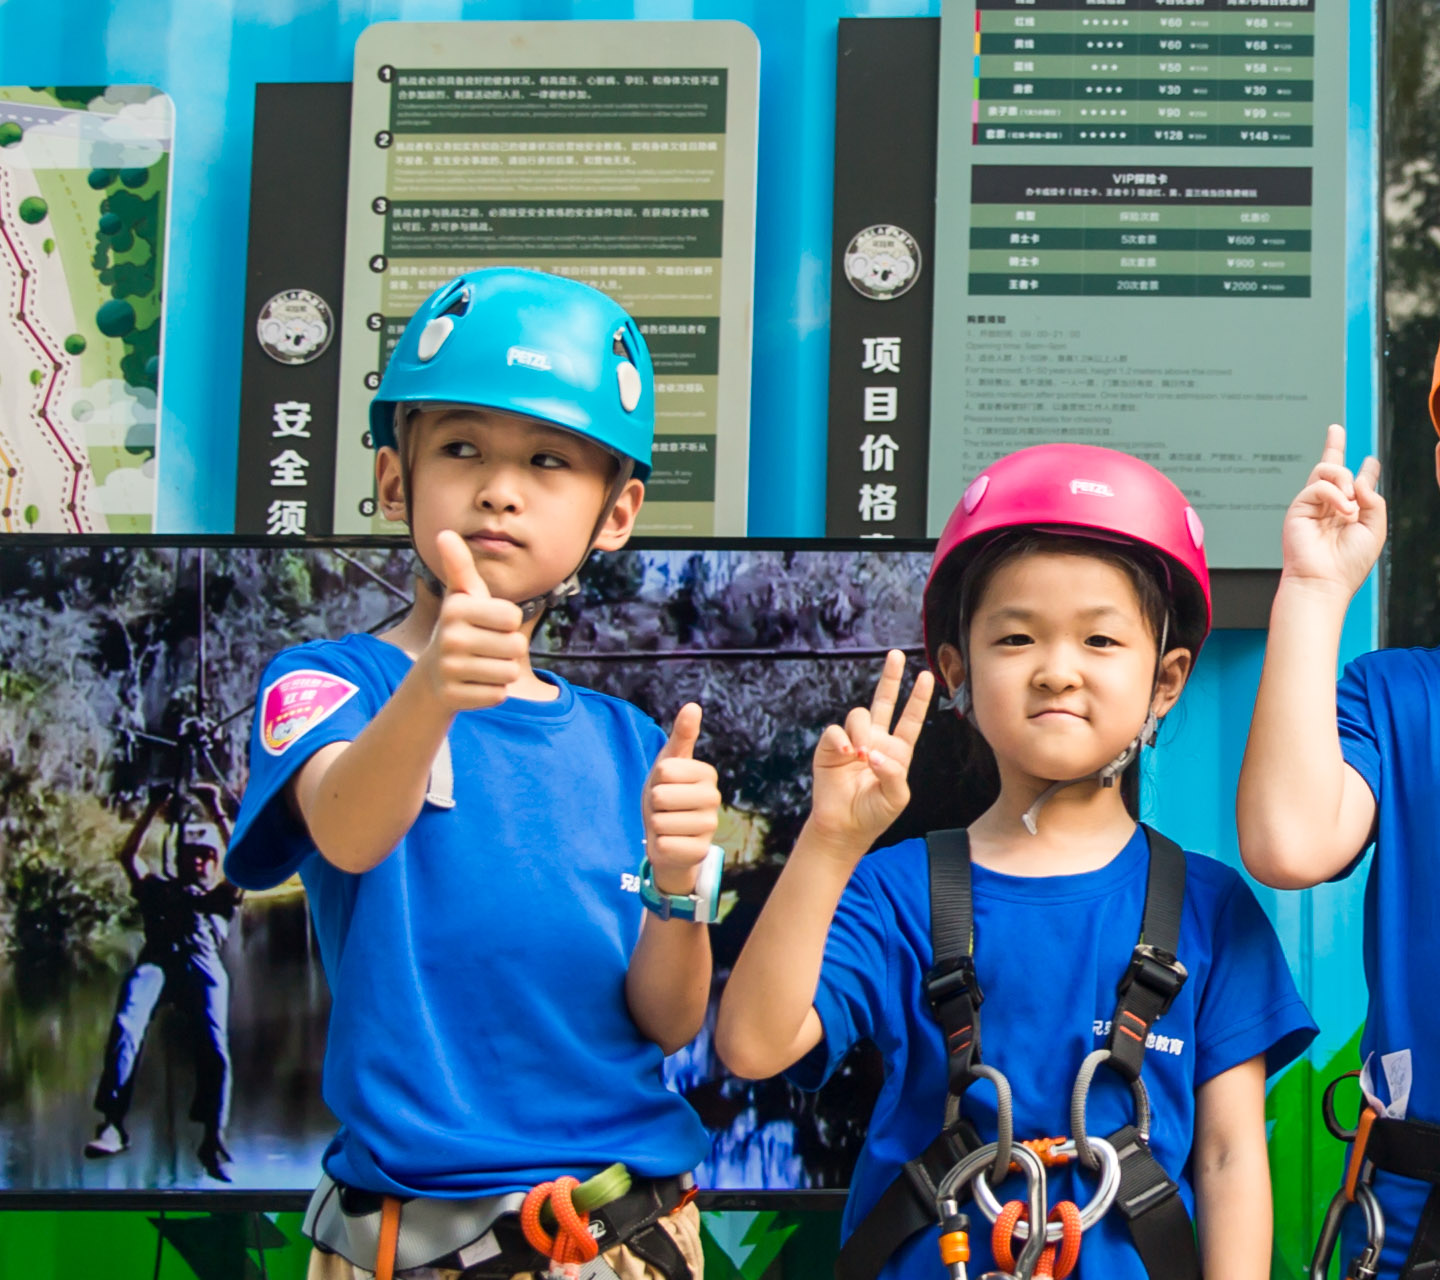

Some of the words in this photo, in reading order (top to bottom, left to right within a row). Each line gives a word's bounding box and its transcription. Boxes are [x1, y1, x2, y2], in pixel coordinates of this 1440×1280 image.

[382, 67, 391, 80] 1
[378, 132, 390, 146] 2
[1112, 173, 1168, 185] VIP探险卡
[376, 199, 387, 212] 3
[373, 258, 384, 270] 4
[370, 316, 382, 329] 5
[507, 347, 552, 370] PETZL
[367, 374, 379, 388] 6
[858, 336, 902, 539] 项目价格
[266, 401, 312, 535] 安全须
[1071, 480, 1115, 497] PETZL
